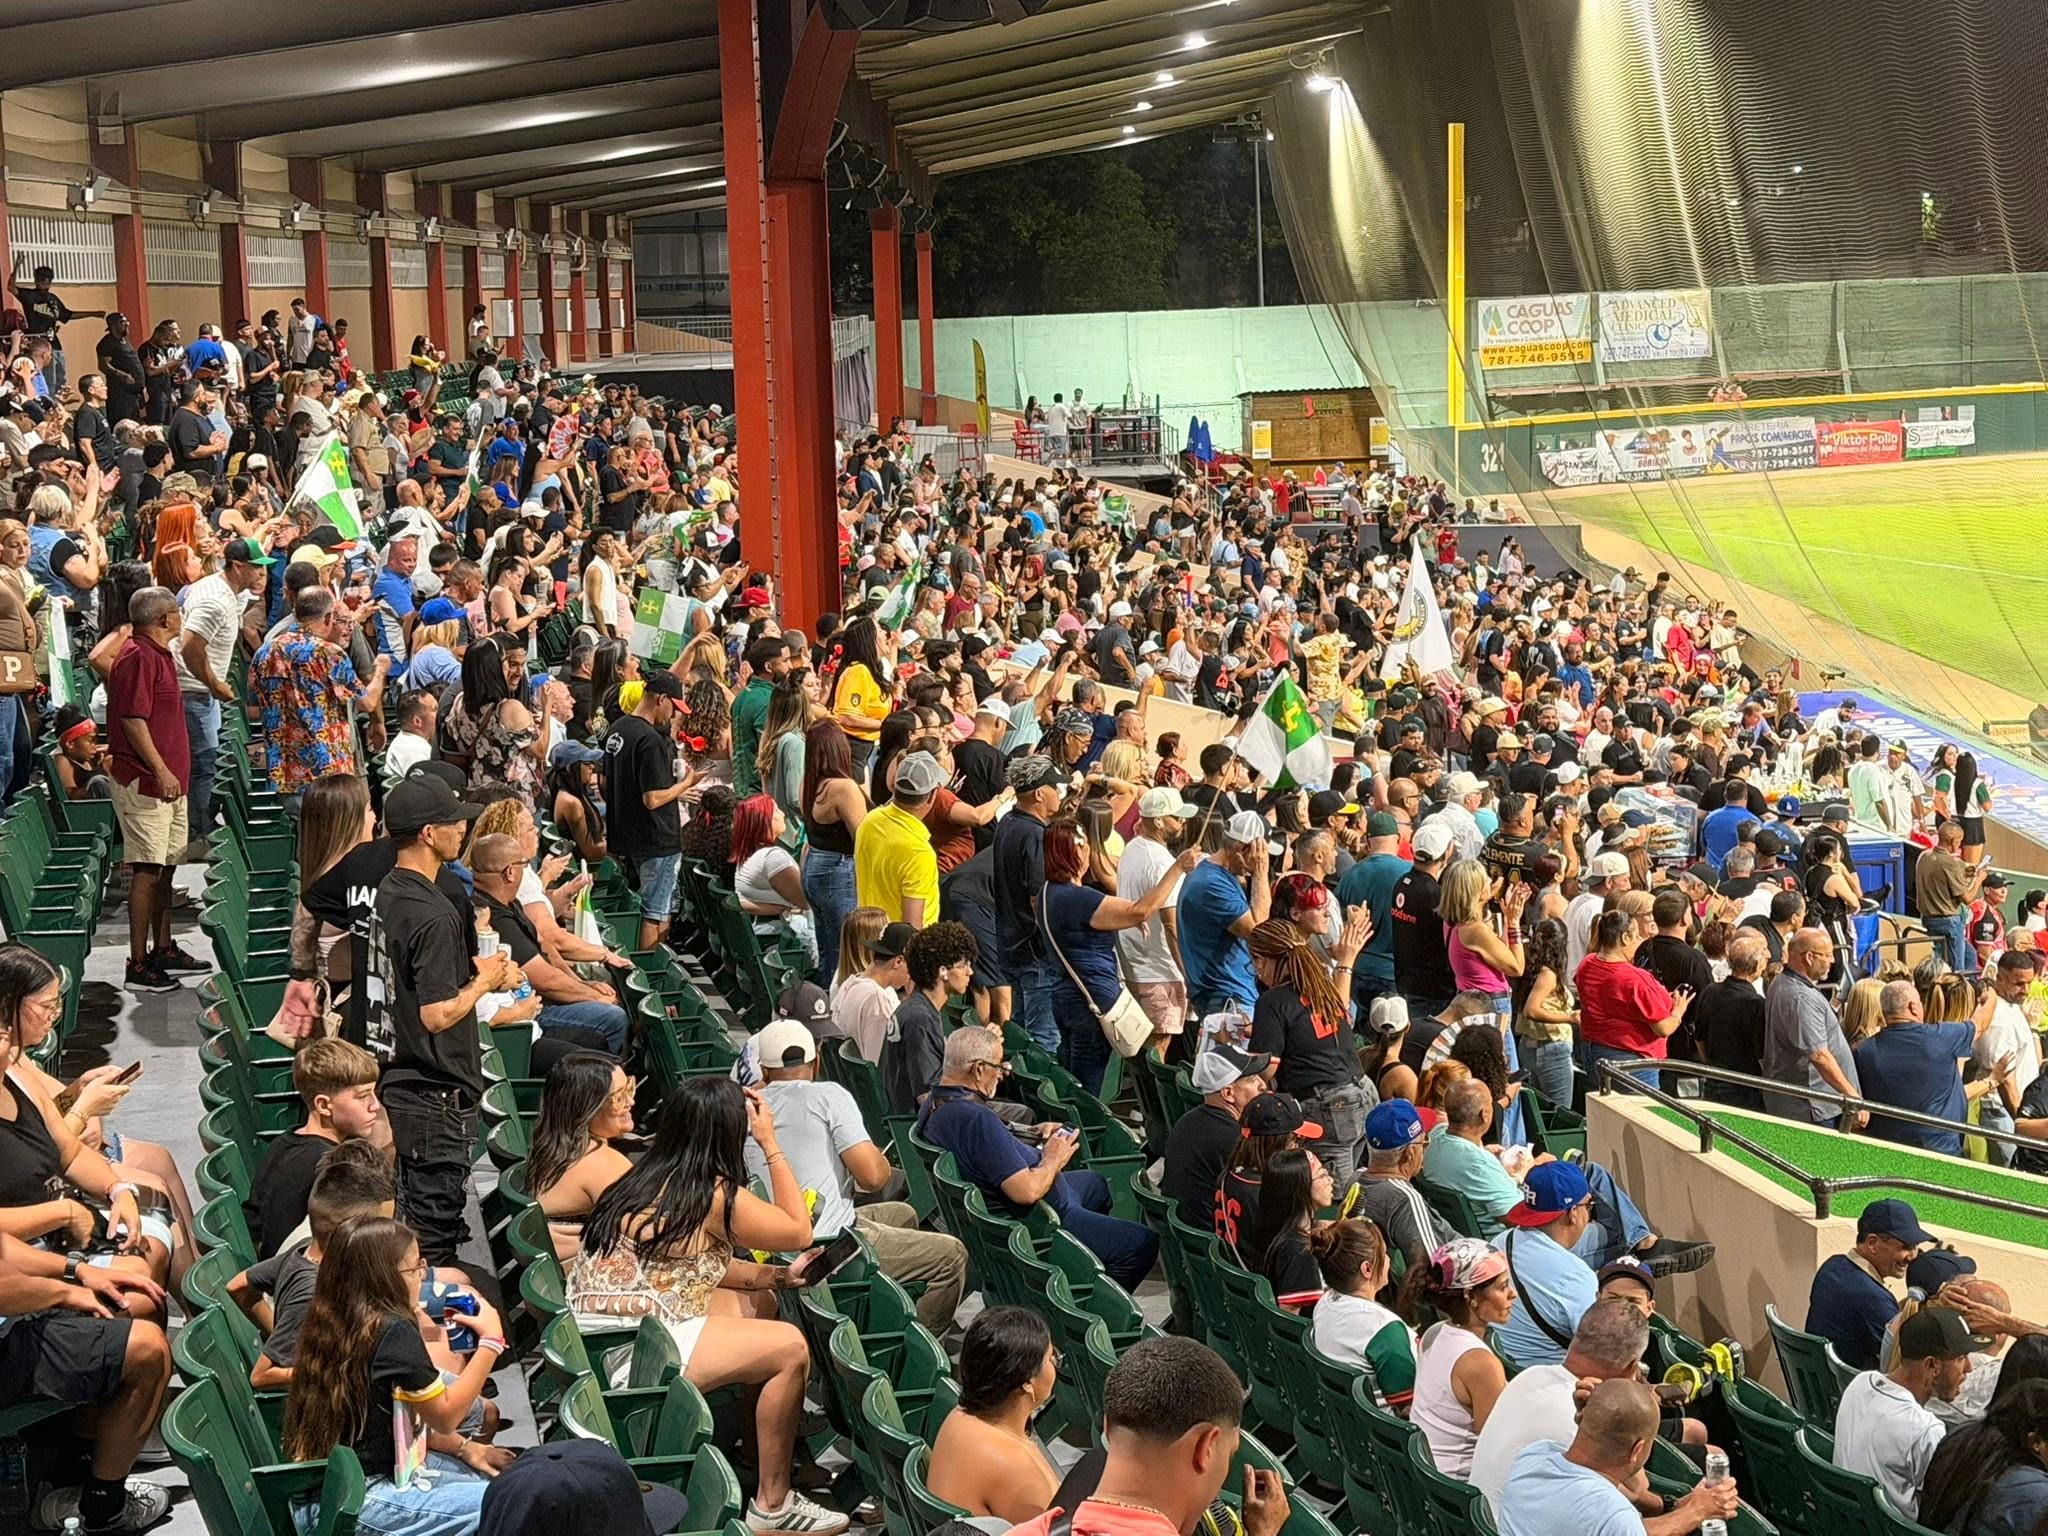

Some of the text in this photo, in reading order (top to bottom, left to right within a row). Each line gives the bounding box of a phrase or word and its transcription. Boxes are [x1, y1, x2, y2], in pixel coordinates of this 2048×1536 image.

[1506, 301, 1574, 319] CAGUAS
[1614, 298, 1676, 311] ADVANCED
[1613, 309, 1673, 322] MEDICAL
[1506, 319, 1555, 335] COOP
[1482, 341, 1592, 355] www.caguascoop.com
[1489, 350, 1584, 366] 787-746-9595
[2, 655, 22, 682] P
